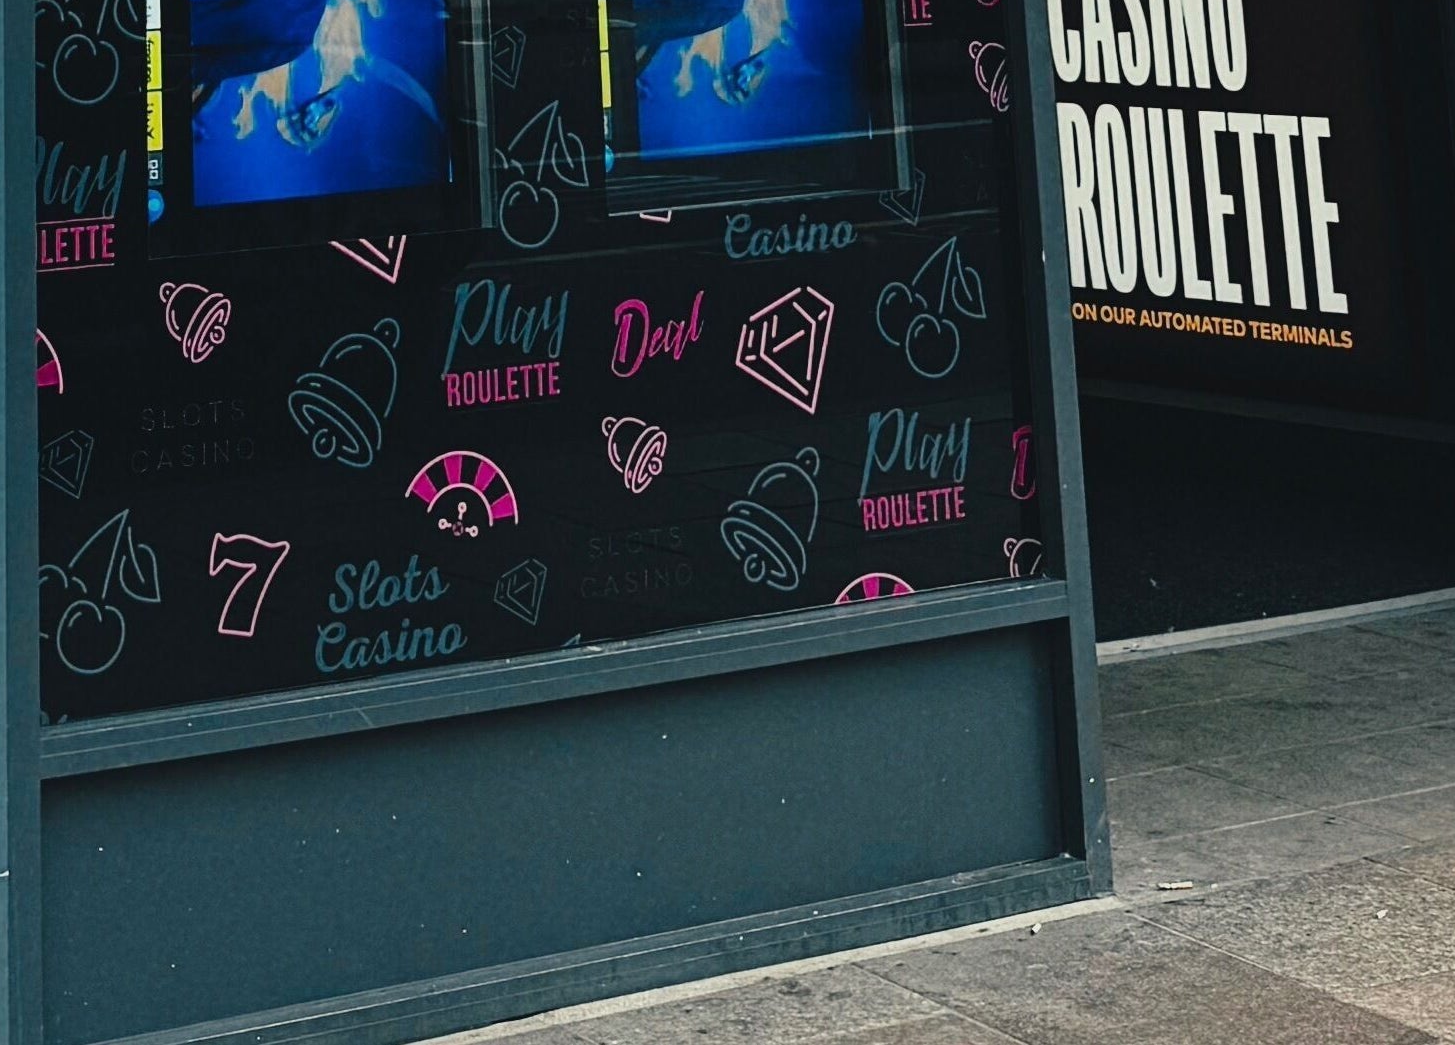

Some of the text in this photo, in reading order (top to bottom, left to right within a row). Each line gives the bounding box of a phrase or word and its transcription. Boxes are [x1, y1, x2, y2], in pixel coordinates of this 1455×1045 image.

[1057, 101, 1348, 313] ROULETTE
[40, 223, 115, 265] LETTE
[724, 213, 858, 259] Casino
[441, 278, 569, 382] Play
[611, 290, 705, 378] Deal
[1072, 302, 1354, 349] ON OUR AUTOMATED TERMINALS
[446, 361, 561, 407] ROULETTE
[858, 408, 972, 506] Play
[862, 485, 966, 531] ROULETTE
[328, 555, 450, 614] Slots
[314, 617, 468, 673] Casino
